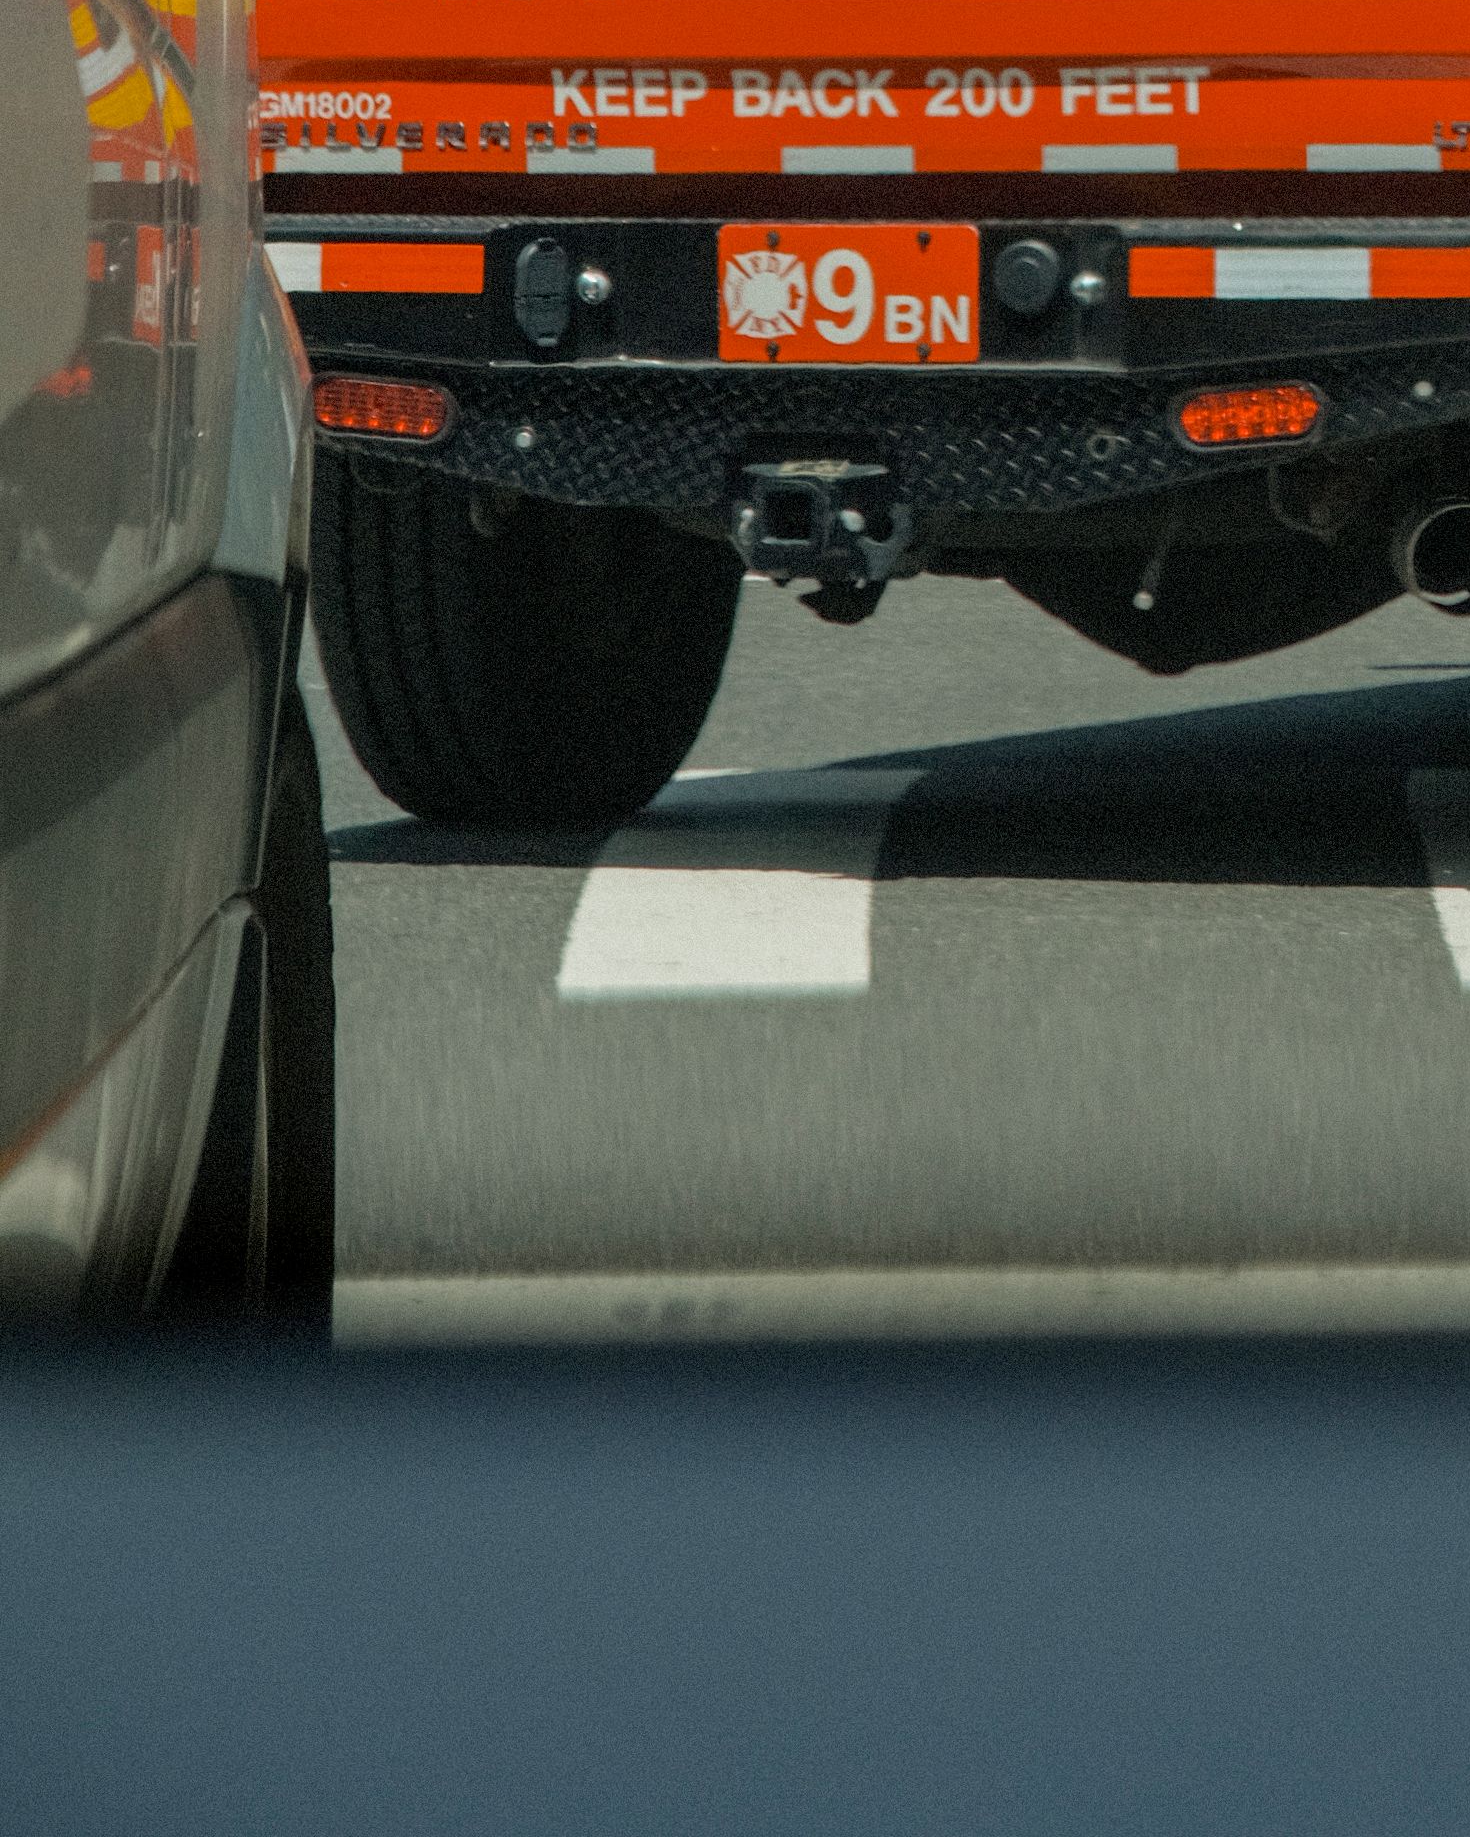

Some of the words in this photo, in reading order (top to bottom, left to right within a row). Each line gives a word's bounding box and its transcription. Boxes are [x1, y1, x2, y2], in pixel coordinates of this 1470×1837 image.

[552, 69, 705, 118] KEEP
[731, 69, 899, 118] BACK
[925, 67, 1035, 118] 200
[1059, 67, 1211, 117] FEET
[261, 122, 597, 153] SILVERADO
[812, 248, 875, 345] 9
[884, 294, 971, 344] BN
